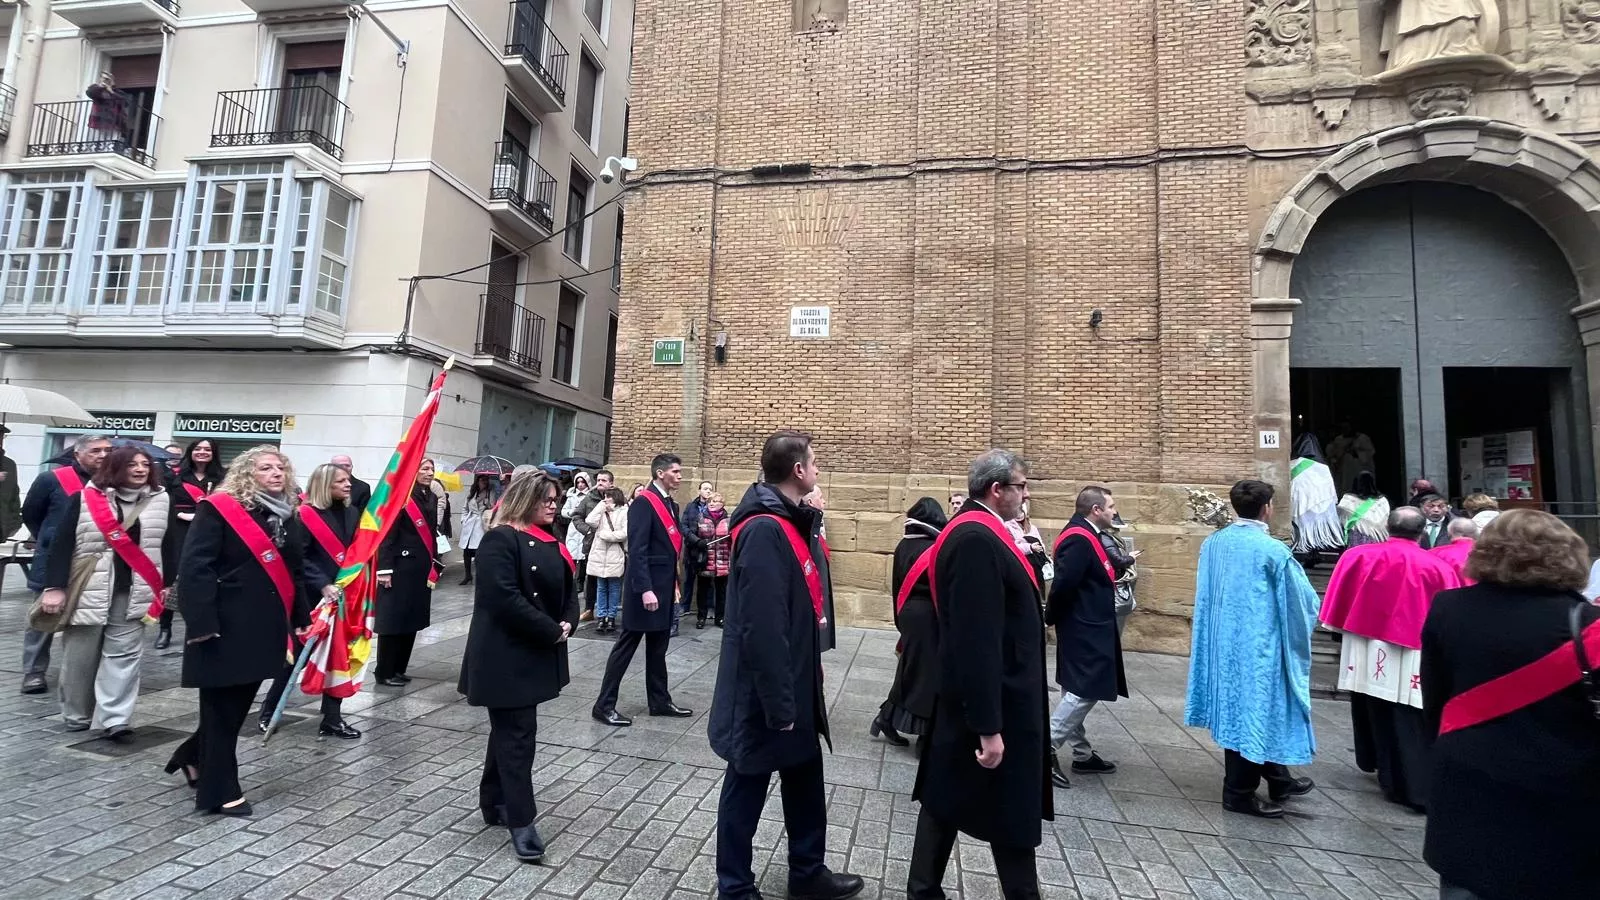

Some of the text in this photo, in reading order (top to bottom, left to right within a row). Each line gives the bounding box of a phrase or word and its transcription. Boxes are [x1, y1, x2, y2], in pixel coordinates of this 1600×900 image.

[63, 416, 152, 430] n'secret
[175, 418, 281, 433] women'secret
[1264, 434, 1276, 444] 18
